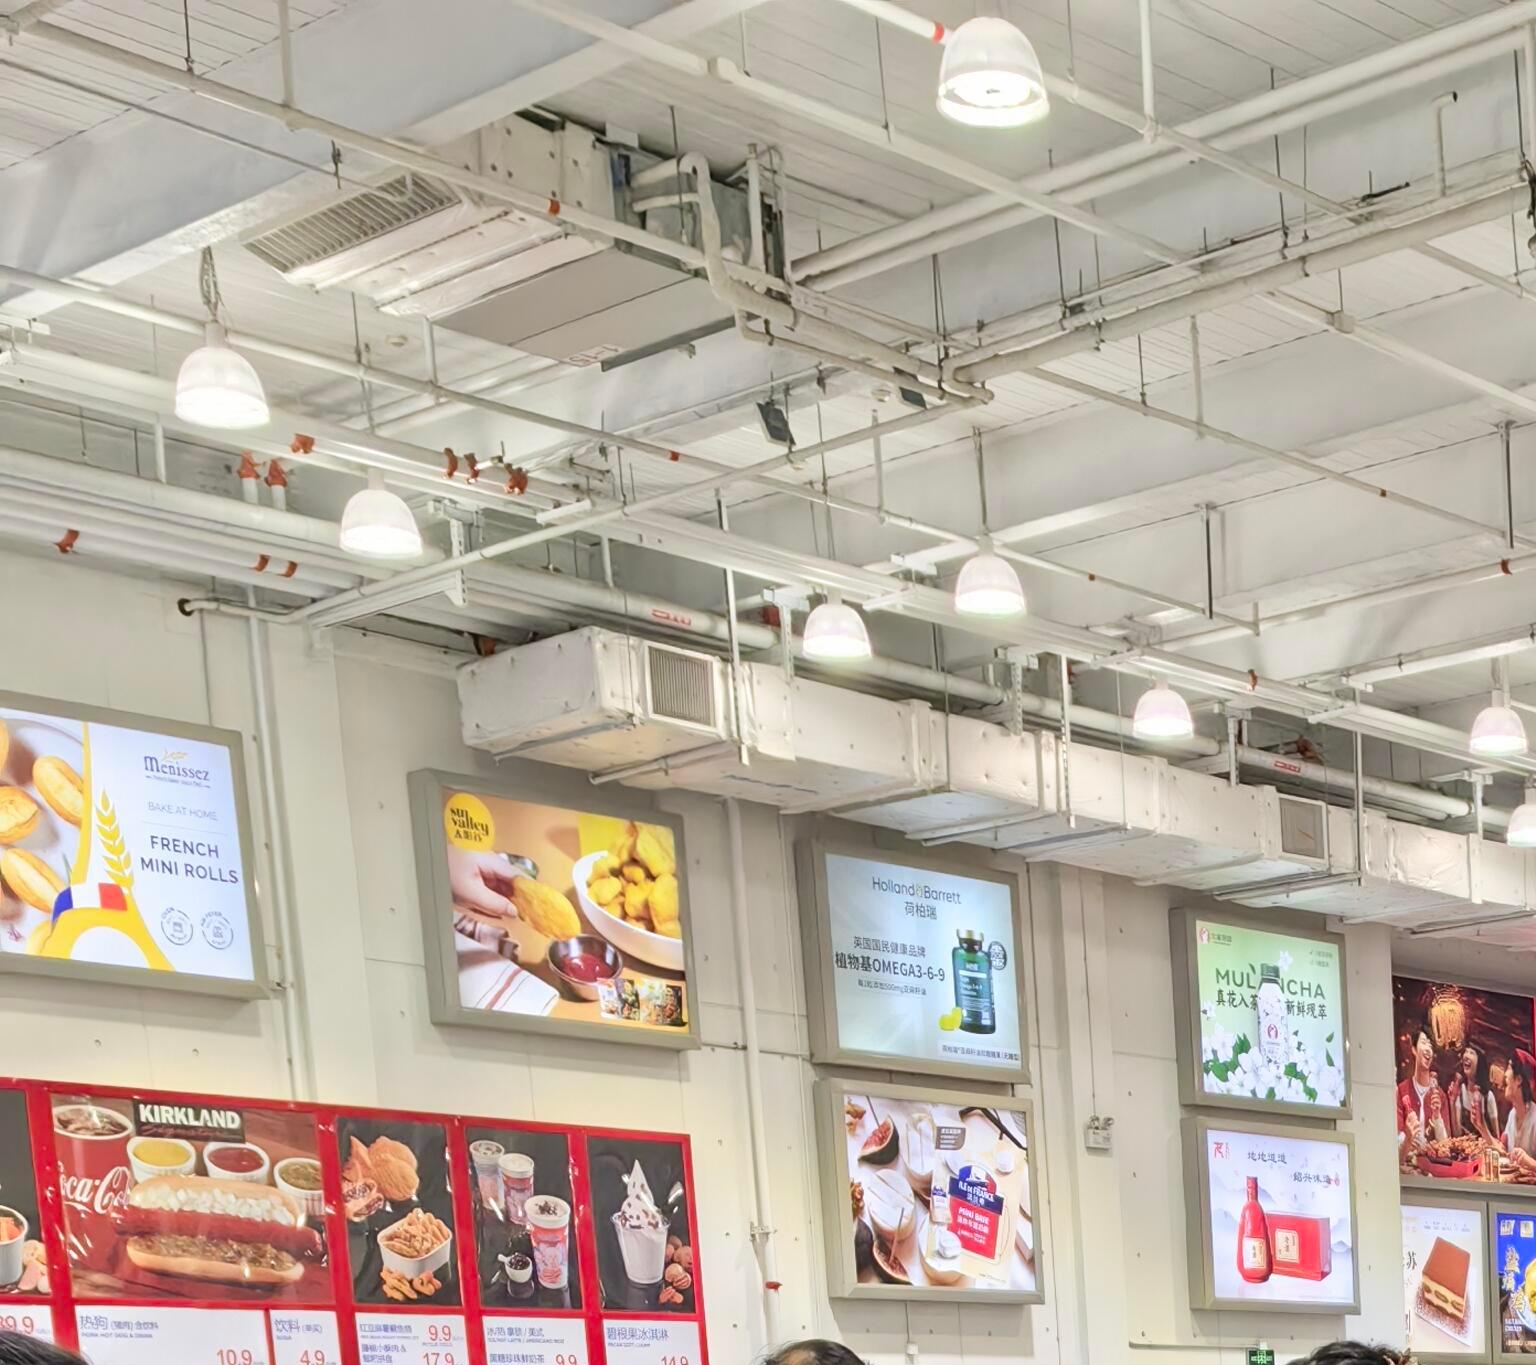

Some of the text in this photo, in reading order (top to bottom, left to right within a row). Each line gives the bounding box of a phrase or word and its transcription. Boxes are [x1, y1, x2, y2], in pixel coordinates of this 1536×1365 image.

[148, 801, 175, 815] BAKE
[175, 805, 188, 817] AT
[150, 835, 219, 859] FRENCH
[140, 856, 239, 884] MINI ROLLS
[1215, 967, 1327, 1001] MULNCHA
[138, 1103, 242, 1130] KIRKLAND
[428, 1324, 451, 1341] 9.9
